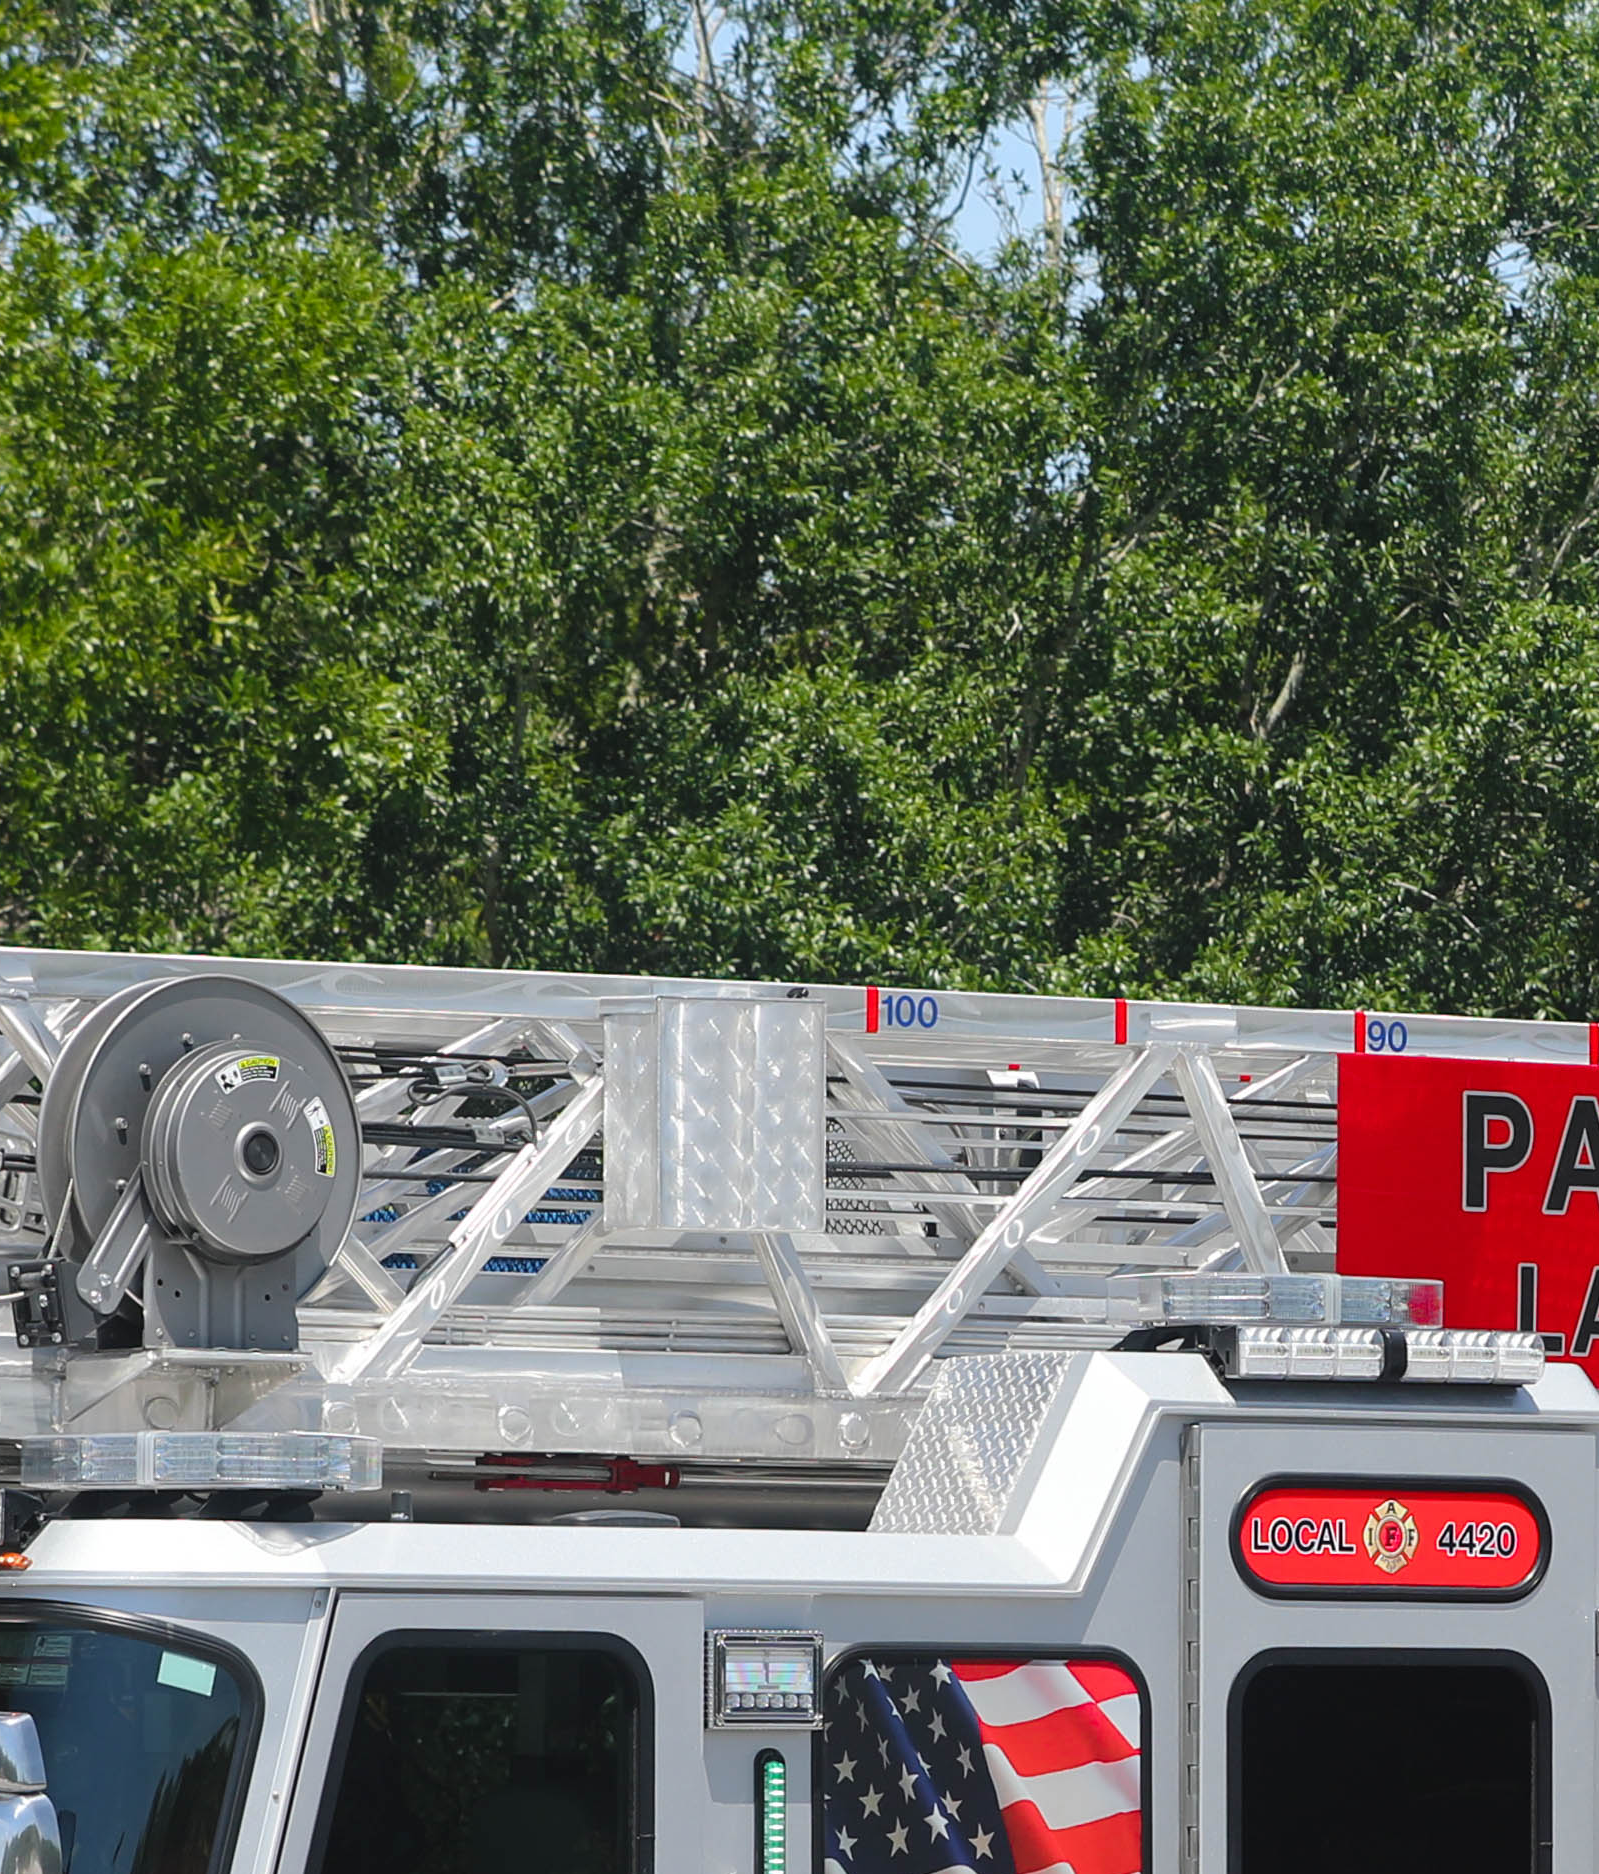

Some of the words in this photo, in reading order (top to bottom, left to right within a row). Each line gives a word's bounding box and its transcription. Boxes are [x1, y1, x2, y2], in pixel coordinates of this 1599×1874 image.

[881, 994, 938, 1029] 100
[1367, 1020, 1408, 1053] 90
[1251, 1517, 1356, 1555] LOCAL
[1436, 1521, 1517, 1559] 4420
